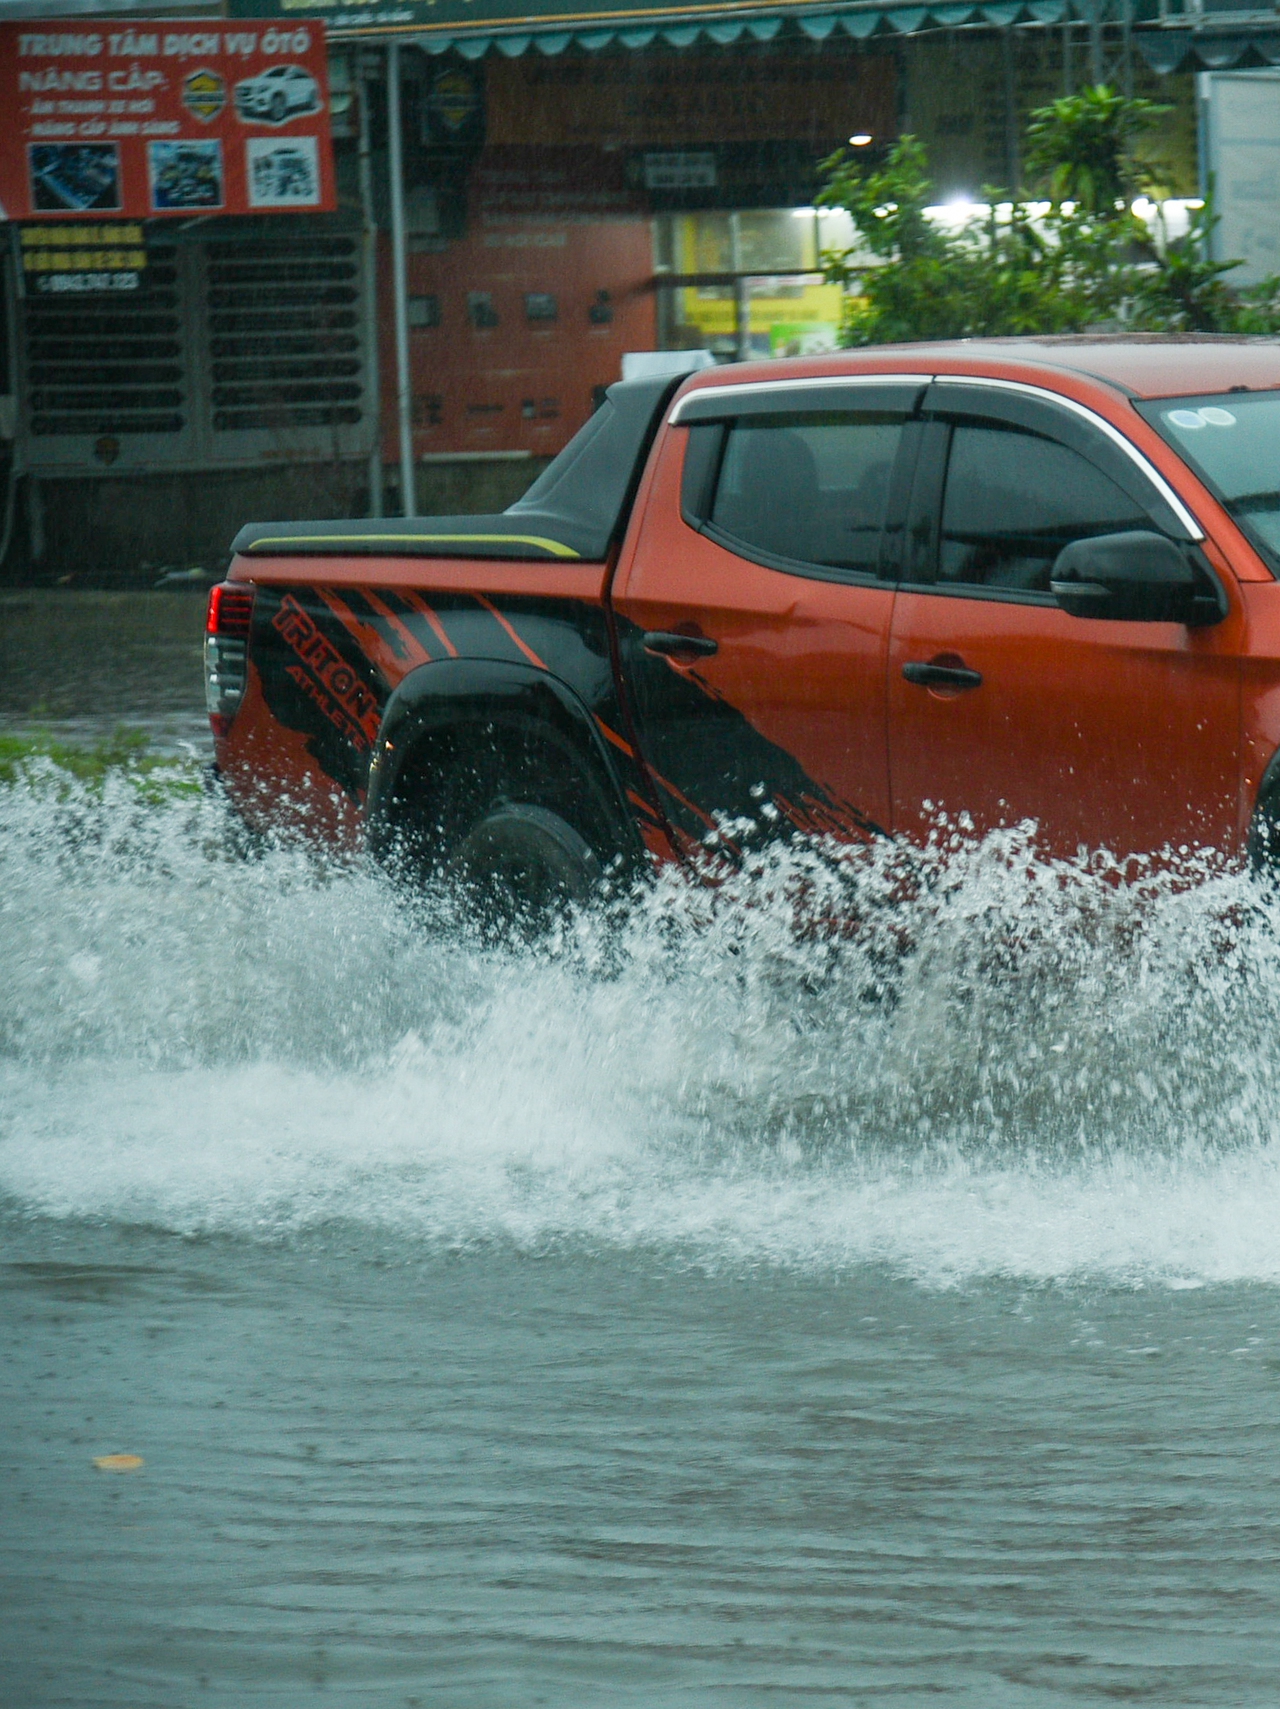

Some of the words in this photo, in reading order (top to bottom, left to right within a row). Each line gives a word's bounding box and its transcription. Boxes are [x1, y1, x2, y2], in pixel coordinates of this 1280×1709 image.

[18, 33, 103, 56] TRUNG
[108, 28, 159, 56] TÂM
[163, 33, 220, 62] DỊCH
[224, 32, 258, 61] VỤ
[261, 27, 311, 55] ÔTÔ
[19, 66, 103, 91] NÂNG
[271, 594, 382, 747] TRITON
